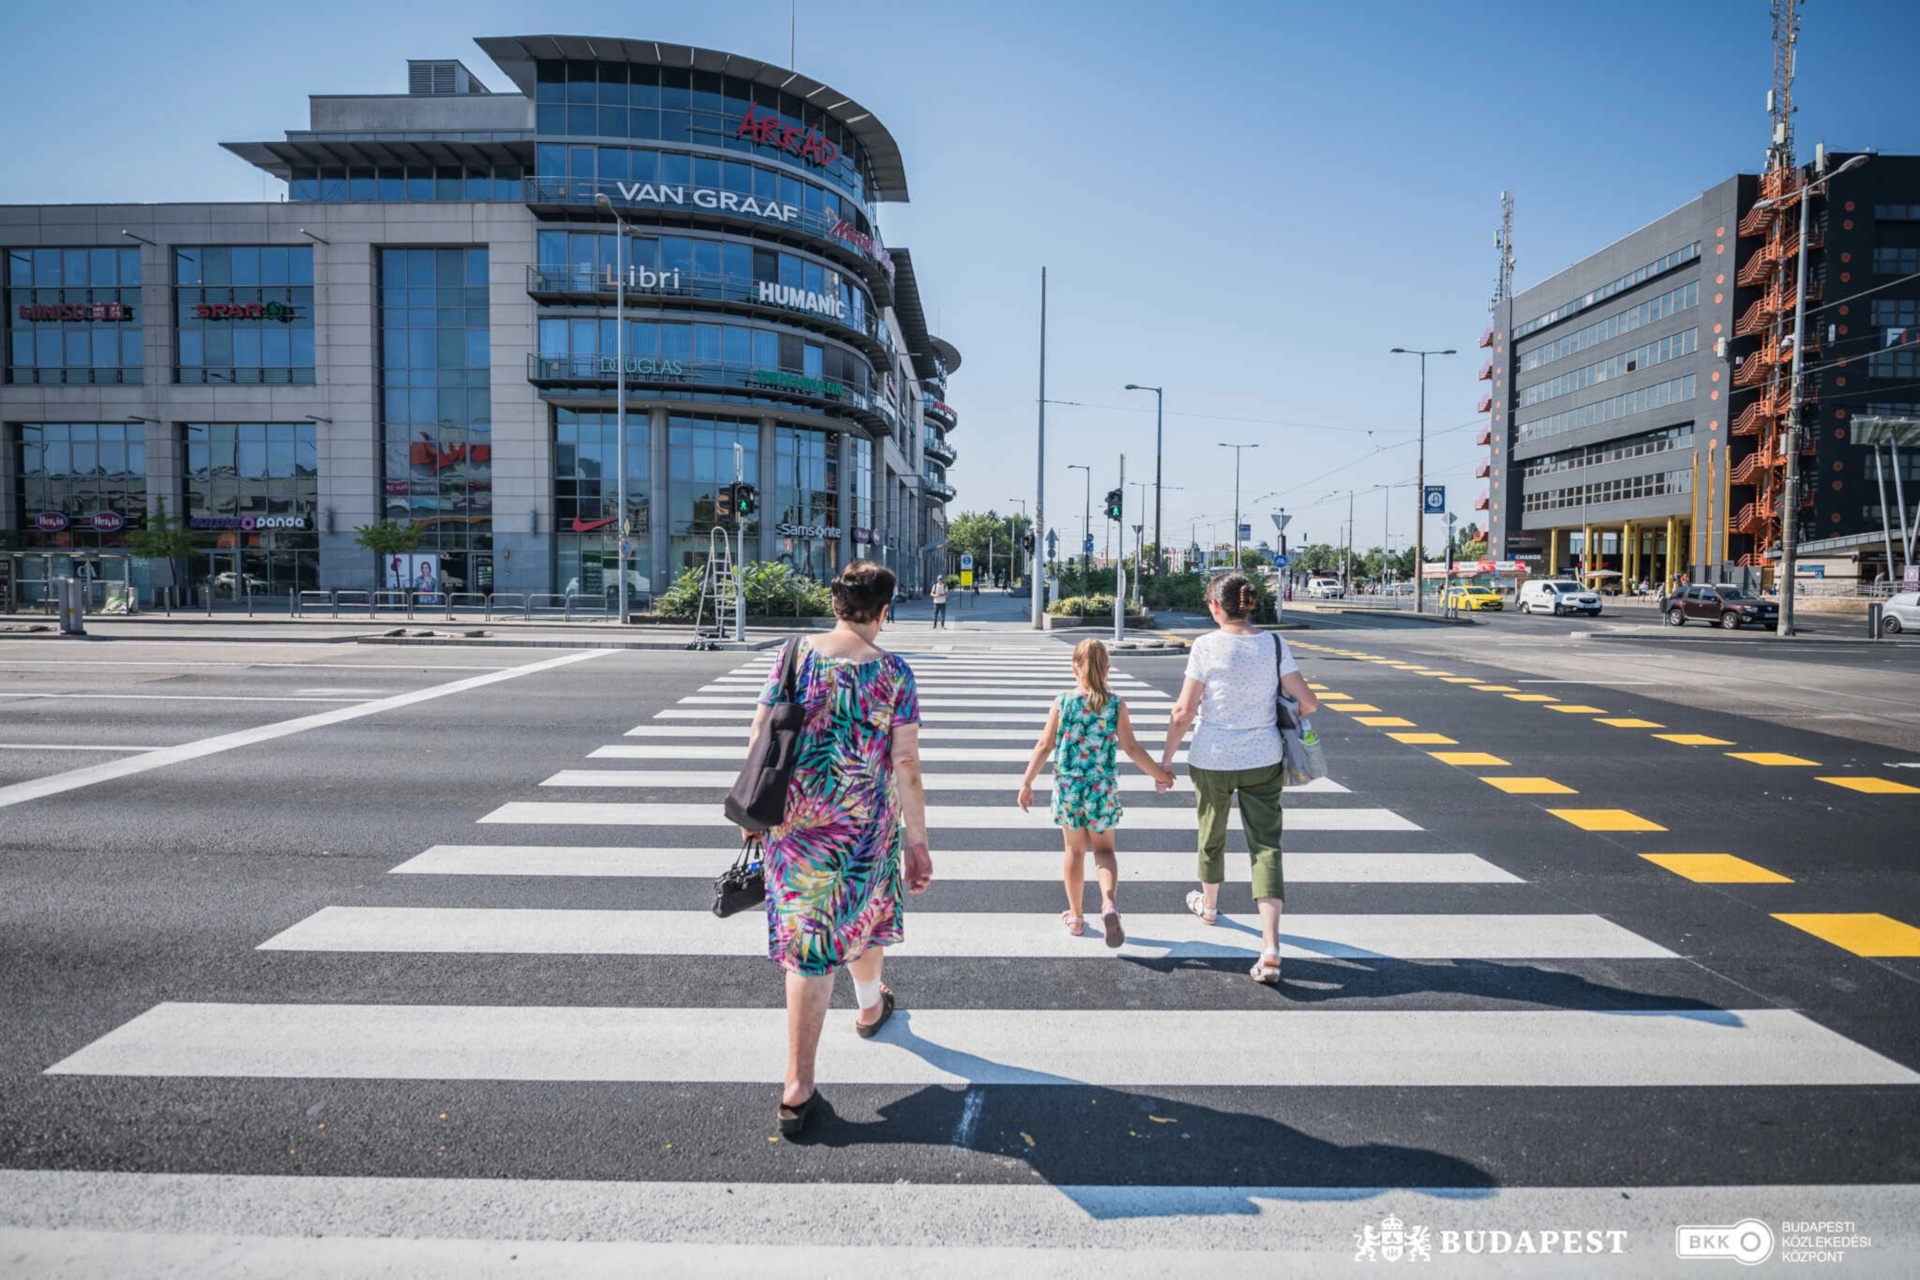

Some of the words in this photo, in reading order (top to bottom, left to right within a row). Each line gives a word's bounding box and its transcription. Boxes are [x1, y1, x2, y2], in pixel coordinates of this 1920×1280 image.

[736, 101, 838, 166] ÁRKÁD
[616, 181, 684, 205] VAN
[693, 189, 799, 222] GRAAF
[606, 263, 680, 290] Libri
[759, 281, 846, 319] HUMANIC
[18, 303, 86, 320] MINISO
[195, 303, 263, 318] SPAR
[39, 516, 64, 527] Hervis
[94, 516, 120, 527] Hervis
[256, 516, 305, 529] panda
[781, 523, 842, 538] Samsonite
